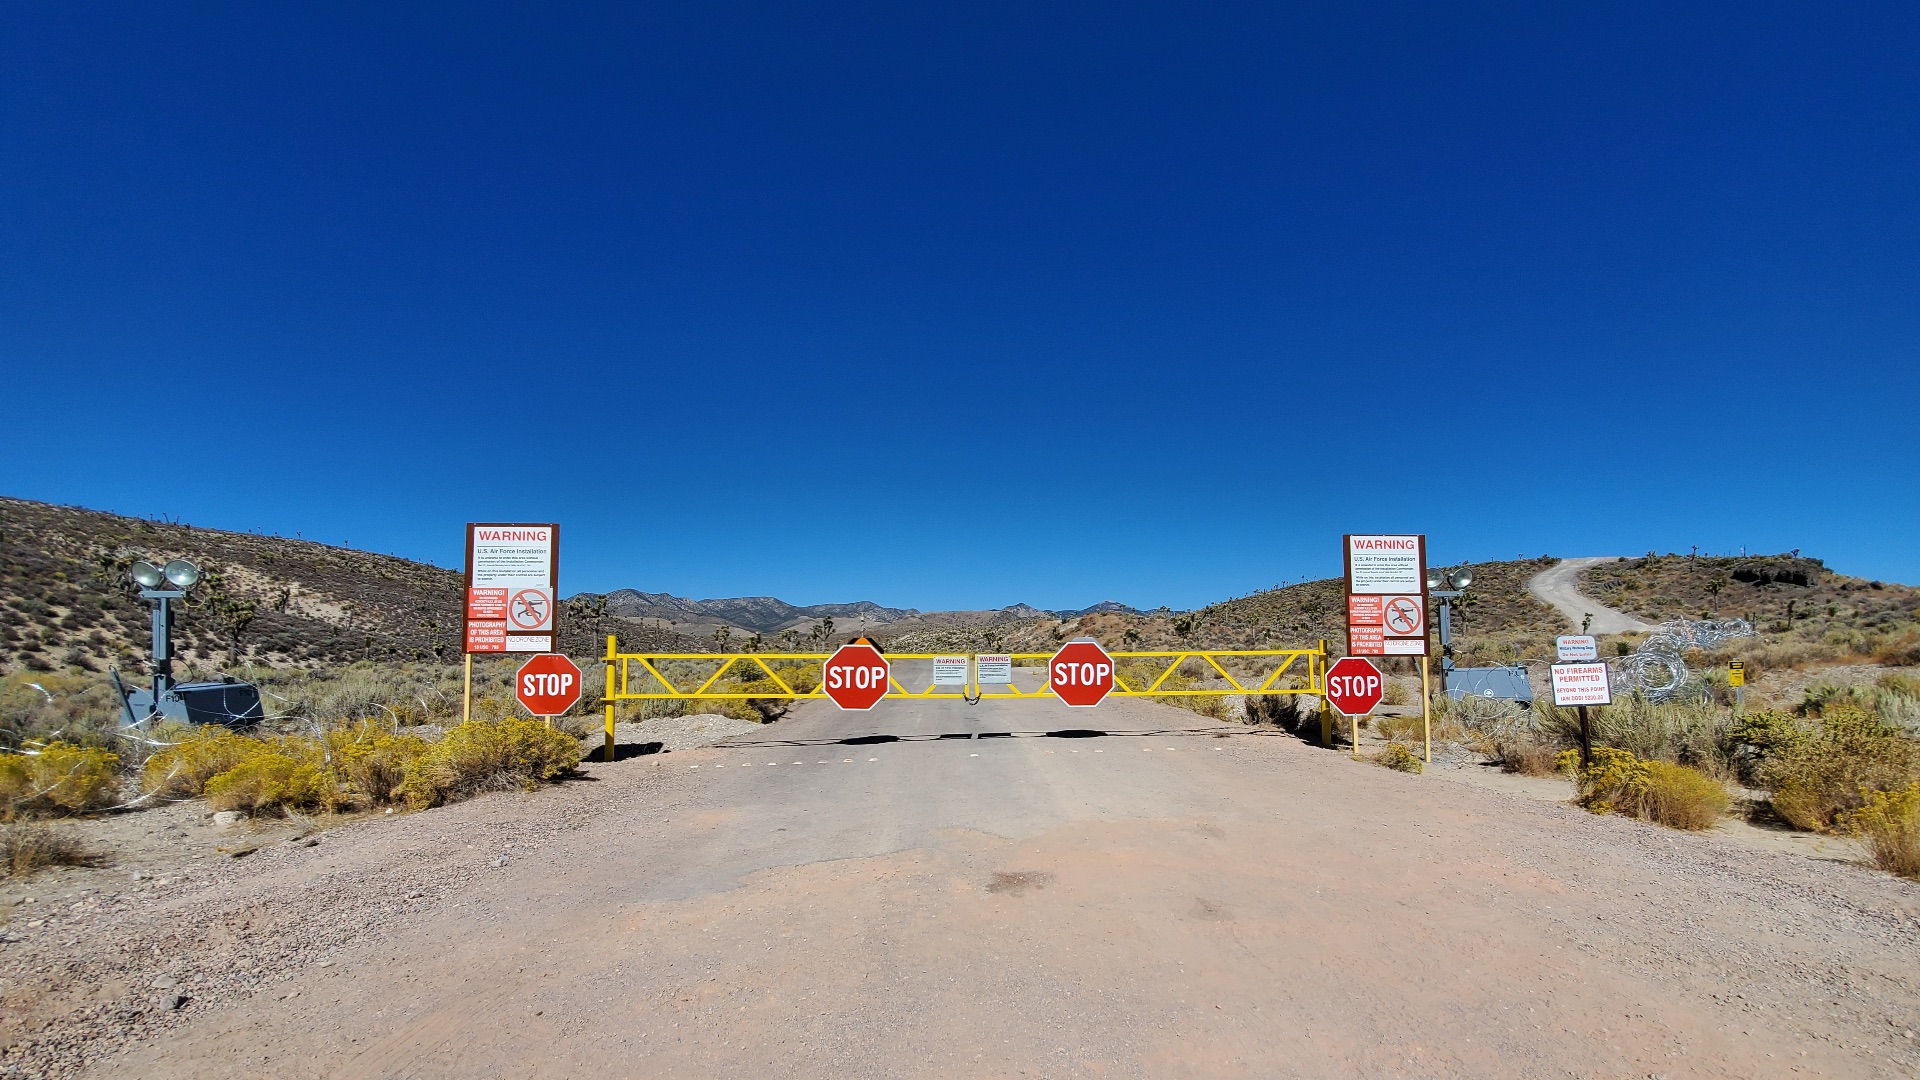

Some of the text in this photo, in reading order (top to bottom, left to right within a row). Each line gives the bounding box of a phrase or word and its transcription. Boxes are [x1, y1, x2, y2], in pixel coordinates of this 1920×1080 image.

[479, 531, 546, 541] WARNING
[1354, 540, 1414, 549] WARNING
[829, 666, 885, 689] STOP
[1054, 662, 1110, 685] STOP
[523, 674, 573, 697] STOP
[1330, 676, 1378, 697] STOP
